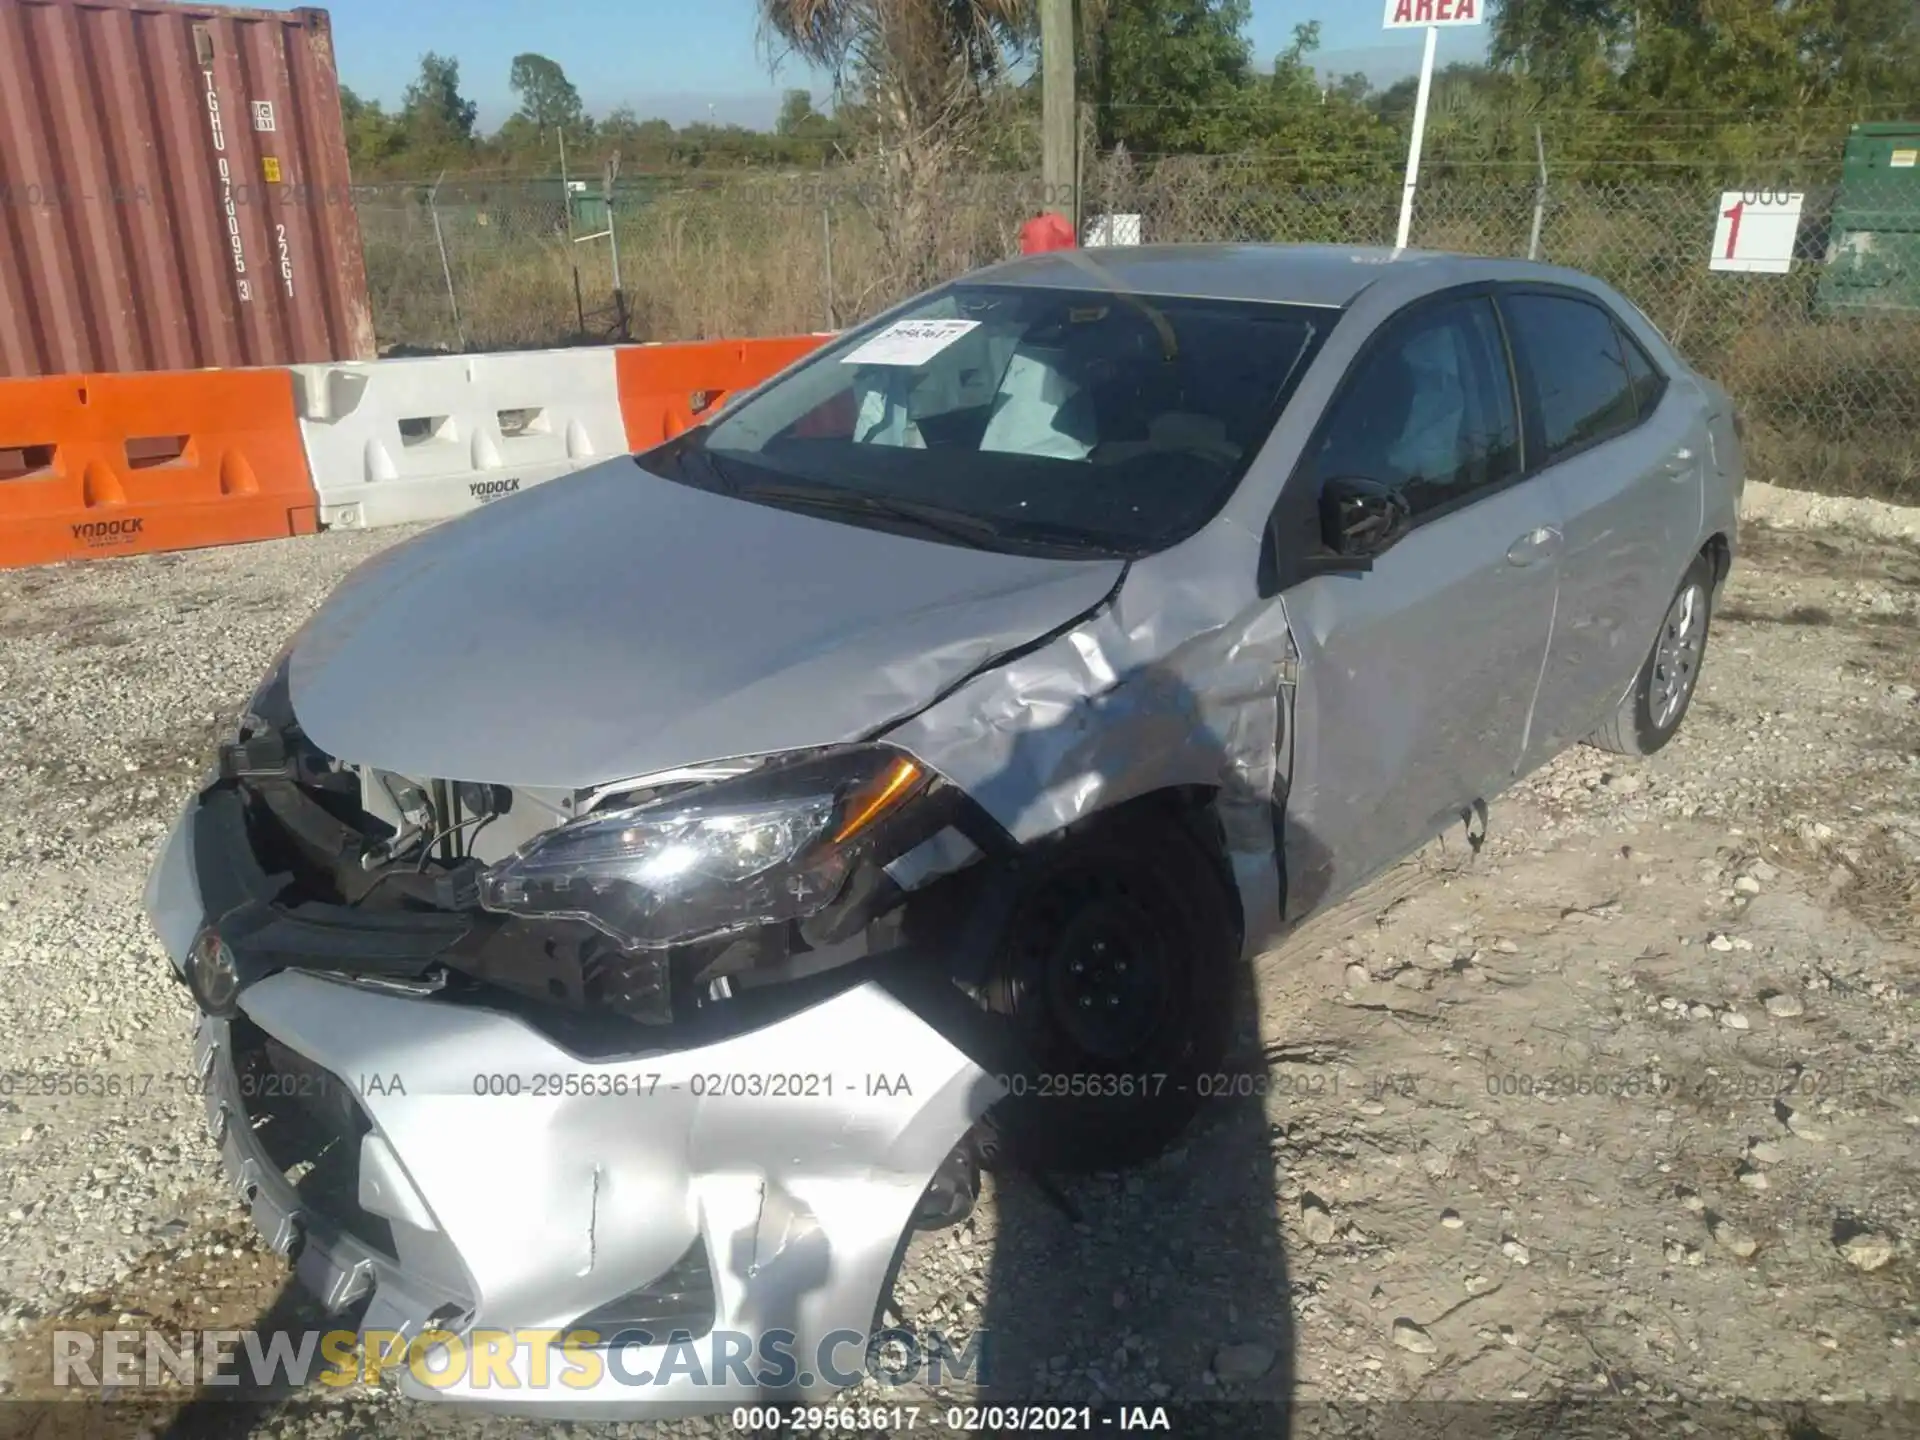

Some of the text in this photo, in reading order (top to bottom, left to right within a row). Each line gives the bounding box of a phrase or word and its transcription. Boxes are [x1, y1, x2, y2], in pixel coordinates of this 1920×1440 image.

[1393, 0, 1475, 22] AREA
[203, 71, 225, 151] TGHU
[1723, 201, 1744, 259] 1
[276, 224, 293, 297] 22G1
[468, 478, 520, 496] YODOCK
[72, 518, 143, 539] YODOCK
